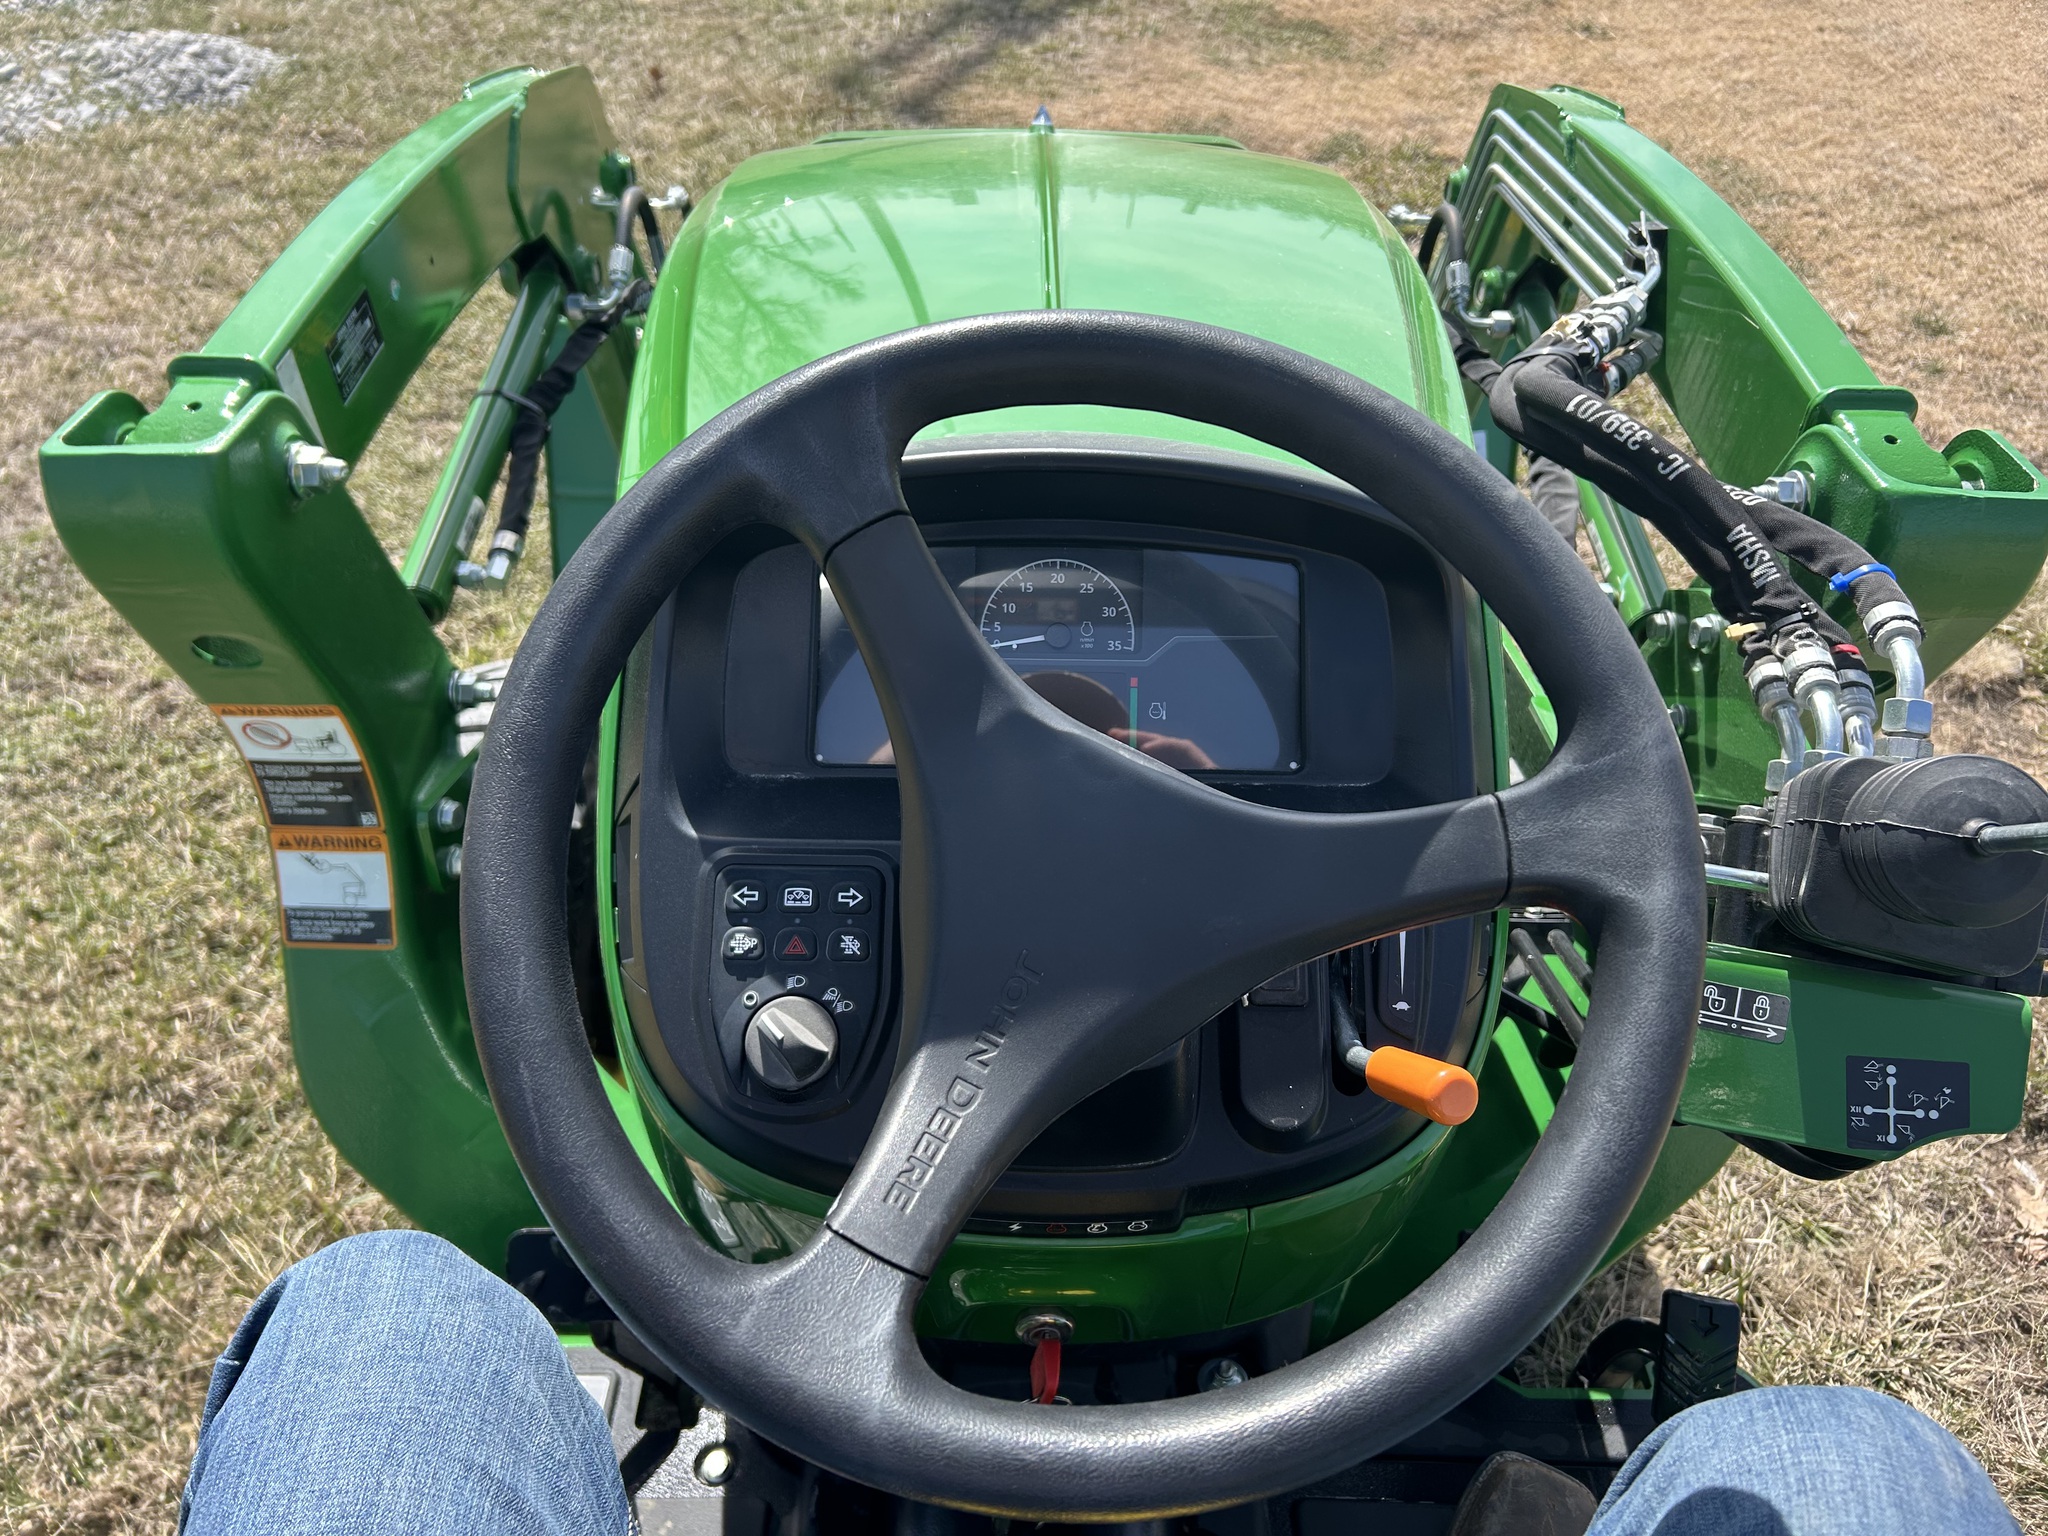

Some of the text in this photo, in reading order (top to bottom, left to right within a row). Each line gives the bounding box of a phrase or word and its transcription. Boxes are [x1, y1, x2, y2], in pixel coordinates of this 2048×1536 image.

[1565, 394, 1653, 451] 359/01
[1726, 523, 1781, 590] MSHA
[1051, 573, 1065, 584] 20
[1019, 582, 1034, 593] 15
[1079, 583, 1095, 594] 25
[1002, 603, 1016, 614] 10
[1102, 606, 1117, 617] 30
[994, 621, 1001, 632] 5
[1107, 640, 1122, 651] 35
[240, 706, 335, 716] WARNING
[293, 835, 382, 849] WARNING
[884, 950, 1044, 1214] JOHN DEERE
